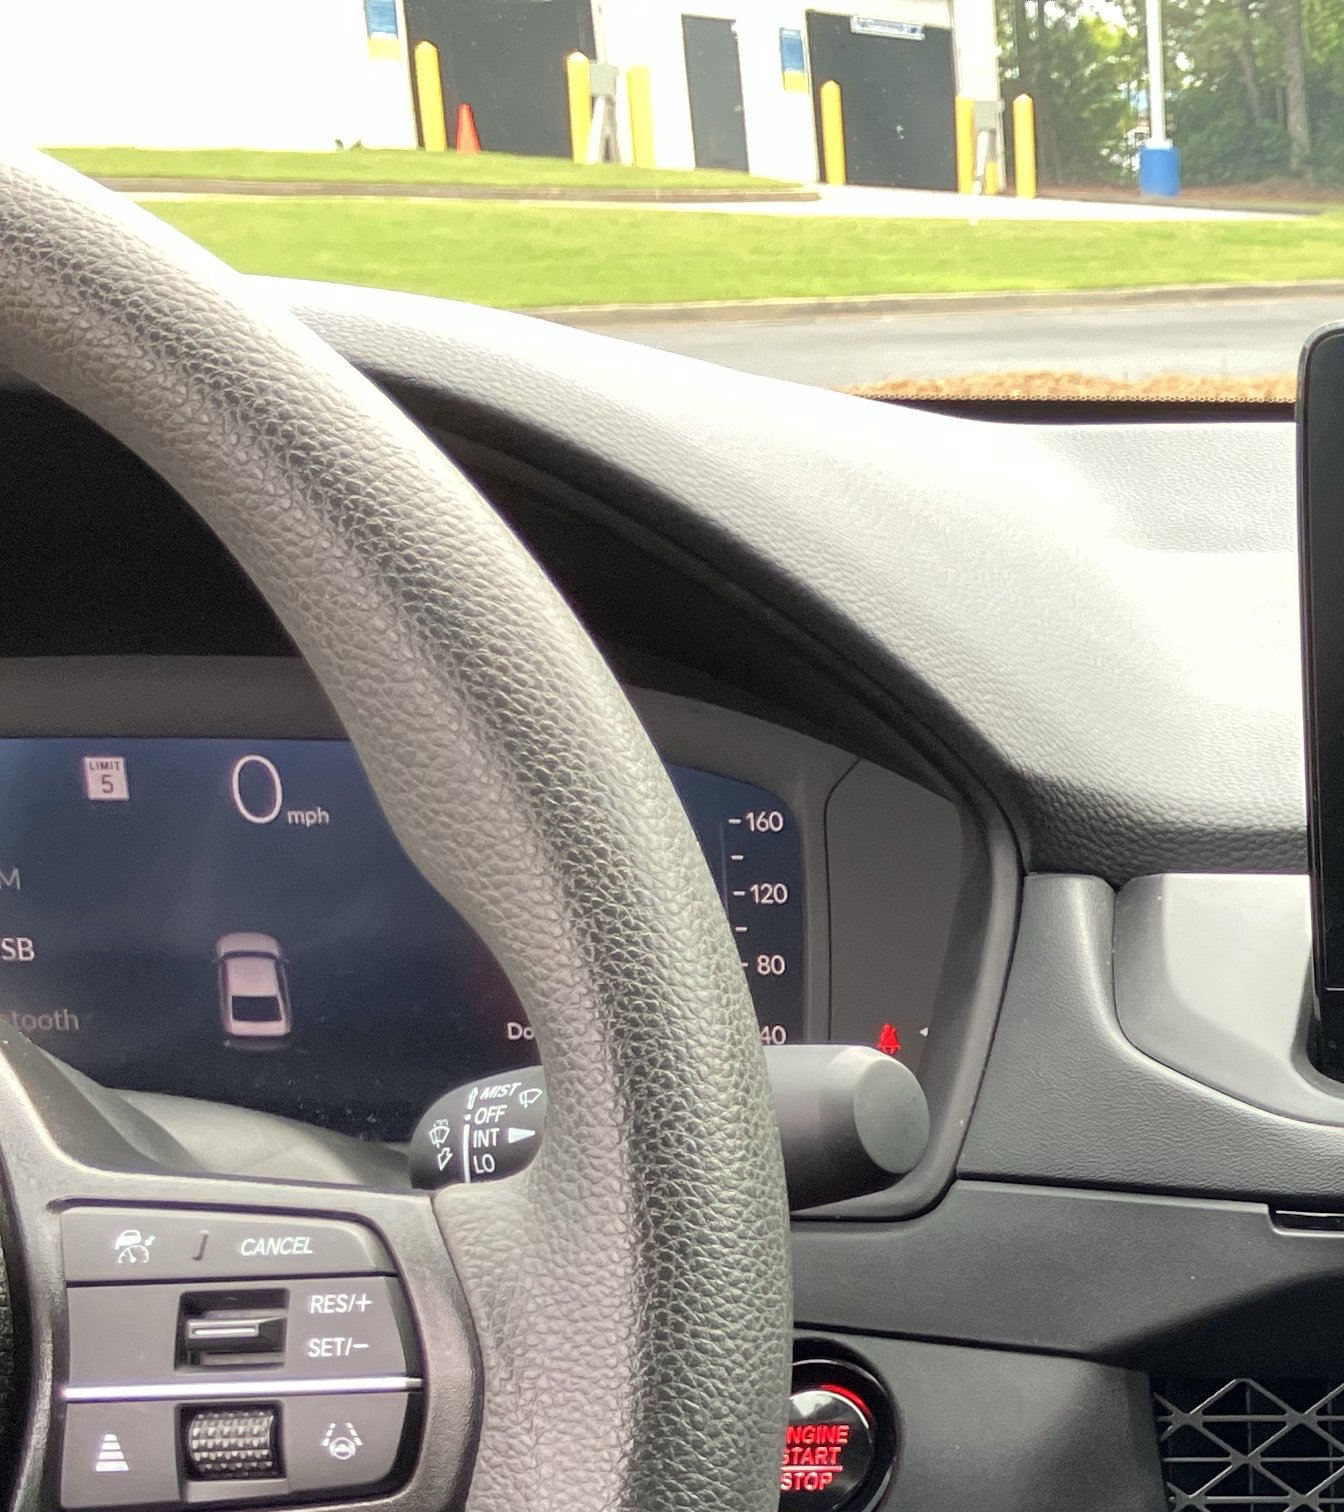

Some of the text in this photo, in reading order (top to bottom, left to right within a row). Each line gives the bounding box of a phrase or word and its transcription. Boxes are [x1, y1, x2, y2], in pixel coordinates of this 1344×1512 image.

[89, 760, 121, 771] LIMIT
[101, 773, 114, 794] 5
[231, 755, 330, 827] 0 mph
[745, 811, 784, 833] 160
[749, 882, 788, 905] 120
[0, 937, 36, 961] SB
[756, 954, 786, 976] 80
[759, 1025, 787, 1046] 40
[480, 1082, 522, 1101] MIST
[474, 1104, 508, 1125] OFF
[473, 1128, 500, 1148] INT
[473, 1153, 496, 1175] LO
[240, 1236, 314, 1256] CANCEL
[309, 1293, 373, 1315] RES/+
[780, 1471, 833, 1491] STOP
